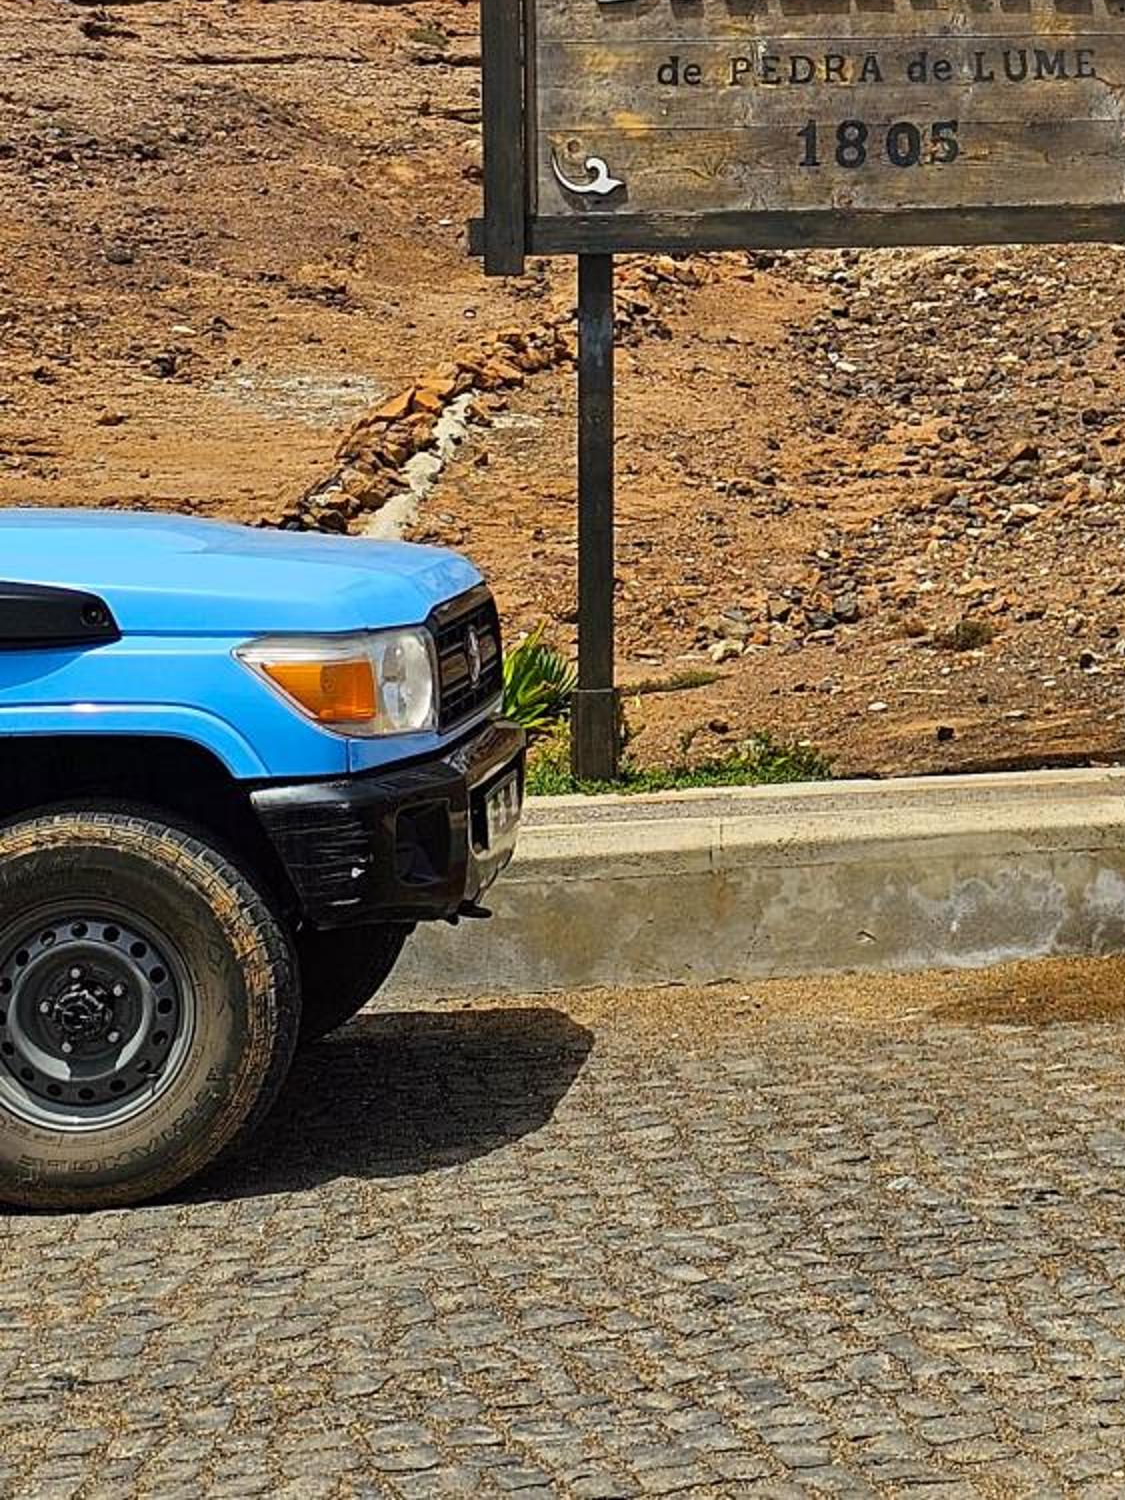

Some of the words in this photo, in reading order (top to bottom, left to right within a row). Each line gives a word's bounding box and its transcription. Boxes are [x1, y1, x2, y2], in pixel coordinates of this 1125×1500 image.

[657, 55, 702, 86] de
[728, 51, 884, 86] PEDRA
[907, 51, 953, 83] de
[974, 49, 1096, 82] LUME
[797, 119, 959, 169] 1805
